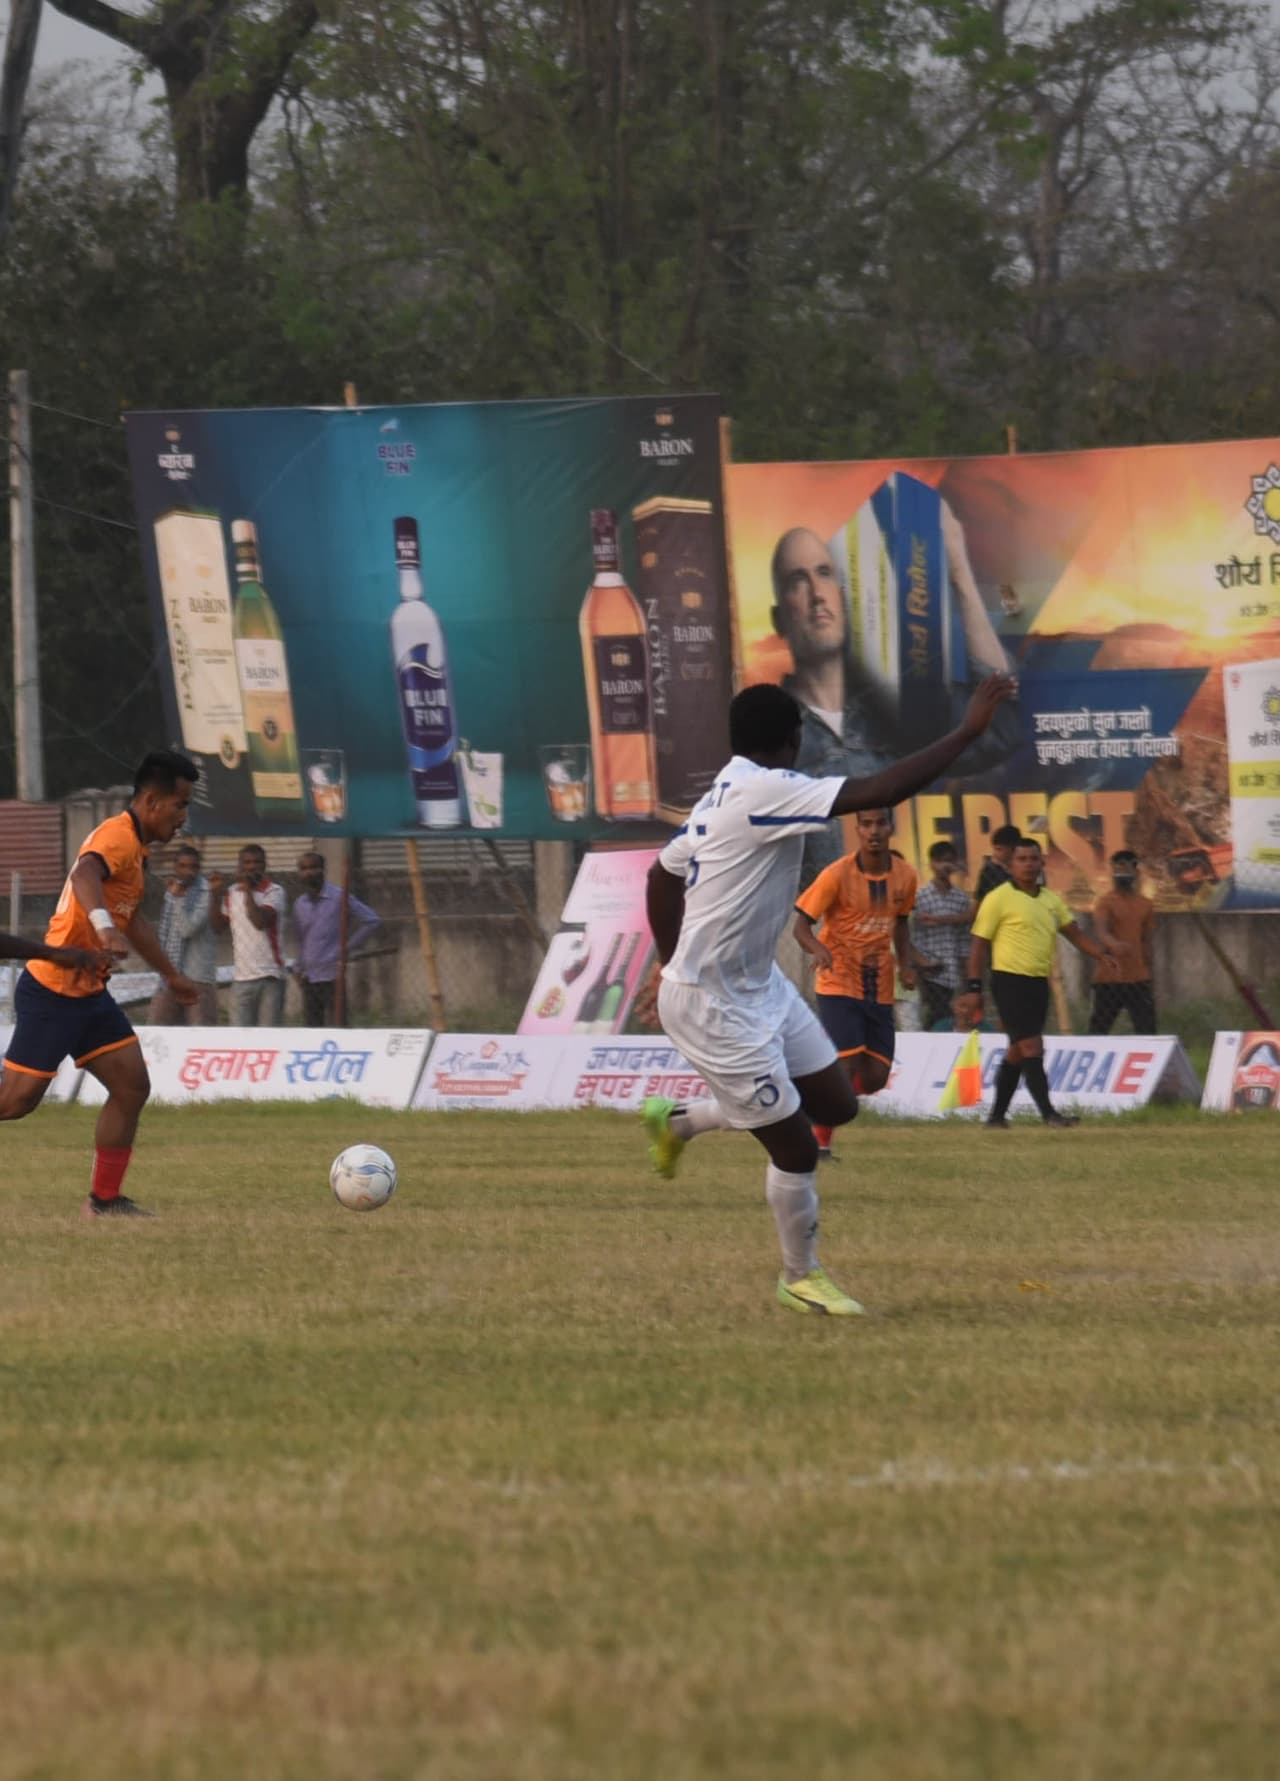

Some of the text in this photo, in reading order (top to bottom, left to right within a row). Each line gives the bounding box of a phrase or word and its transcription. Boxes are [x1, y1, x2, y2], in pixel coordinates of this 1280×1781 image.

[377, 443, 415, 459] BLUE
[639, 438, 694, 457] BARON
[385, 461, 410, 475] FIN
[644, 597, 670, 716] BARON
[600, 679, 645, 696] BARON
[413, 708, 445, 726] FIN
[179, 1047, 280, 1091] हुलास
[284, 1039, 373, 1085] स्टील
[752, 1072, 780, 1108] 5
